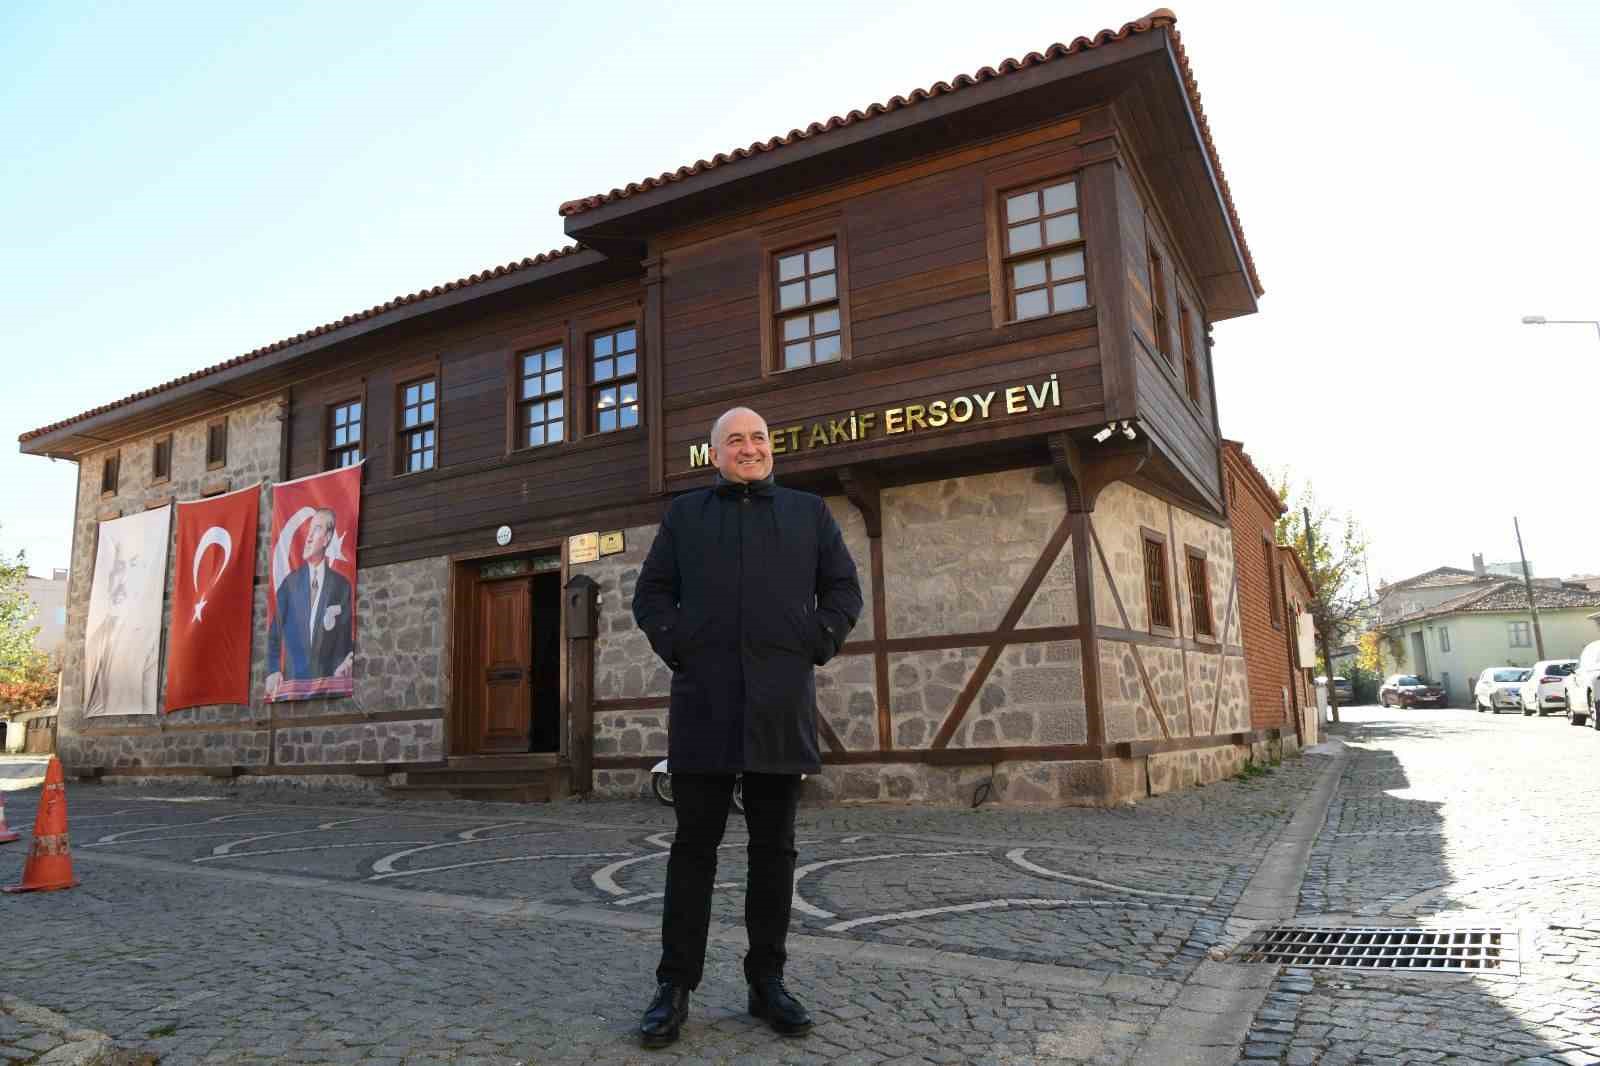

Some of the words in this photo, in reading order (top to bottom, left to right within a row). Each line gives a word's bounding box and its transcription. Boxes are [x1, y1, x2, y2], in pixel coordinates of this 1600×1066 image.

[690, 425, 802, 468] MET
[808, 411, 877, 447] AKİF
[885, 391, 995, 434] ERSOY
[1005, 373, 1060, 413] EVİ
